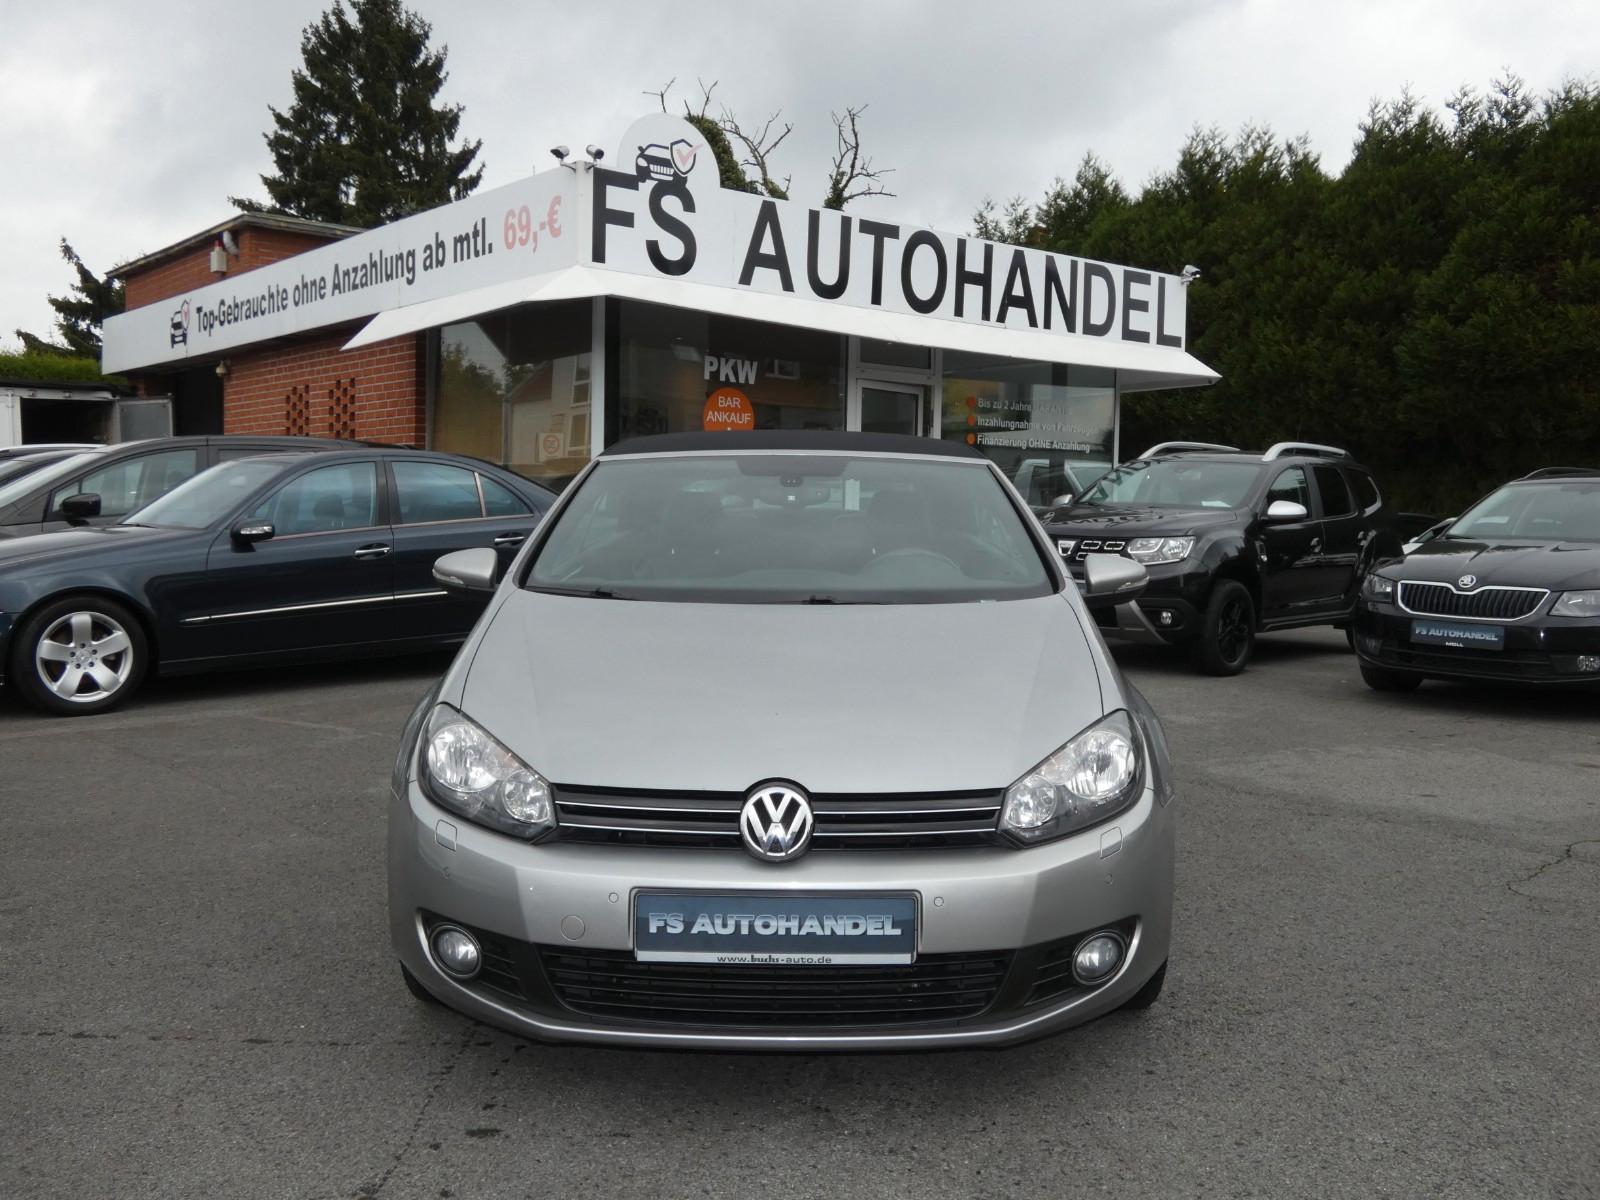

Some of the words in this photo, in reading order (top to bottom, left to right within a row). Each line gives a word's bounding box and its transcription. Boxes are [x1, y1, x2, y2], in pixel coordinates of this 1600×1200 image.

[592, 167, 697, 275] FS
[738, 200, 1182, 348] AUTOHANDEL
[196, 283, 288, 336] Top-Gebrauchte
[293, 275, 326, 307] ohne
[332, 249, 416, 296] Anzahlung
[423, 232, 446, 272] ab
[453, 217, 493, 264] mtl.
[704, 355, 758, 385] PKW
[718, 396, 741, 408] BAR
[978, 398, 991, 408] Bis
[993, 400, 1002, 409] zu
[1004, 400, 1009, 410] 2
[1010, 400, 1033, 412] Jahre
[707, 410, 751, 424] ANKAUF
[977, 417, 1040, 431] Inzahlungnahme
[1042, 423, 1056, 432] von
[977, 434, 1027, 449] Finanzierung
[1028, 439, 1051, 449] OHNE
[1052, 440, 1090, 453] Anzahlung
[1428, 628, 1498, 641] AUTOHANDEL
[649, 912, 684, 933] FS
[691, 914, 902, 936] AUTOHANDEL
